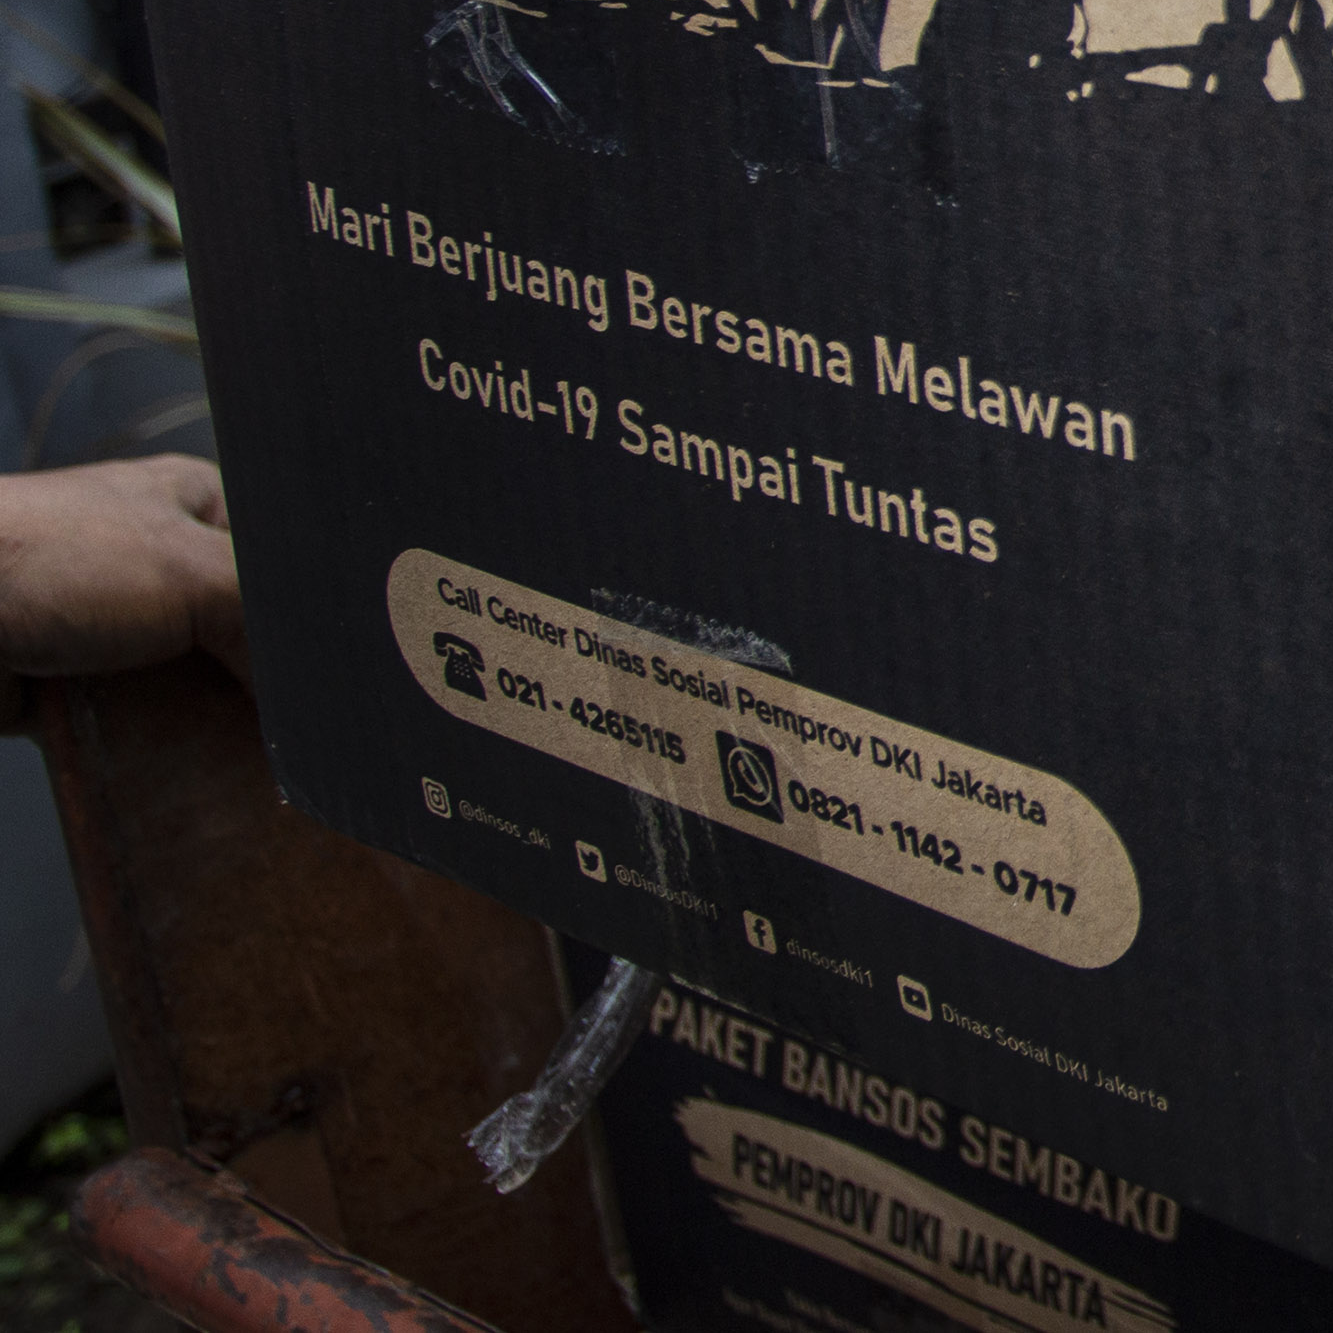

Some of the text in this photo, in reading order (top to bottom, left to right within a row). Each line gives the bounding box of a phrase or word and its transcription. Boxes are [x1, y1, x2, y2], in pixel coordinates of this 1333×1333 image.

[307, 181, 1137, 461] Mari Berjuang Bersama Melawan
[419, 337, 999, 563] Covid-19 Sampai Tuntas
[437, 577, 1047, 827] Call Center Dinas Sosial Pemprov DKI Jakarta
[497, 667, 547, 711] 021
[570, 696, 686, 765] 4265115
[787, 780, 864, 836] 0821
[891, 820, 964, 876] 1142
[993, 861, 1077, 916] 0717
[786, 938, 874, 988] dinsosdki1
[941, 1002, 1168, 1112] Dinas Sosial DKI Jakarta
[648, 988, 1181, 1243] PAKET BANSOS SEMBAKO
[731, 1134, 882, 1236] PEMPROV
[889, 1199, 941, 1264] DKI
[950, 1229, 1108, 1330] JAKARTA
